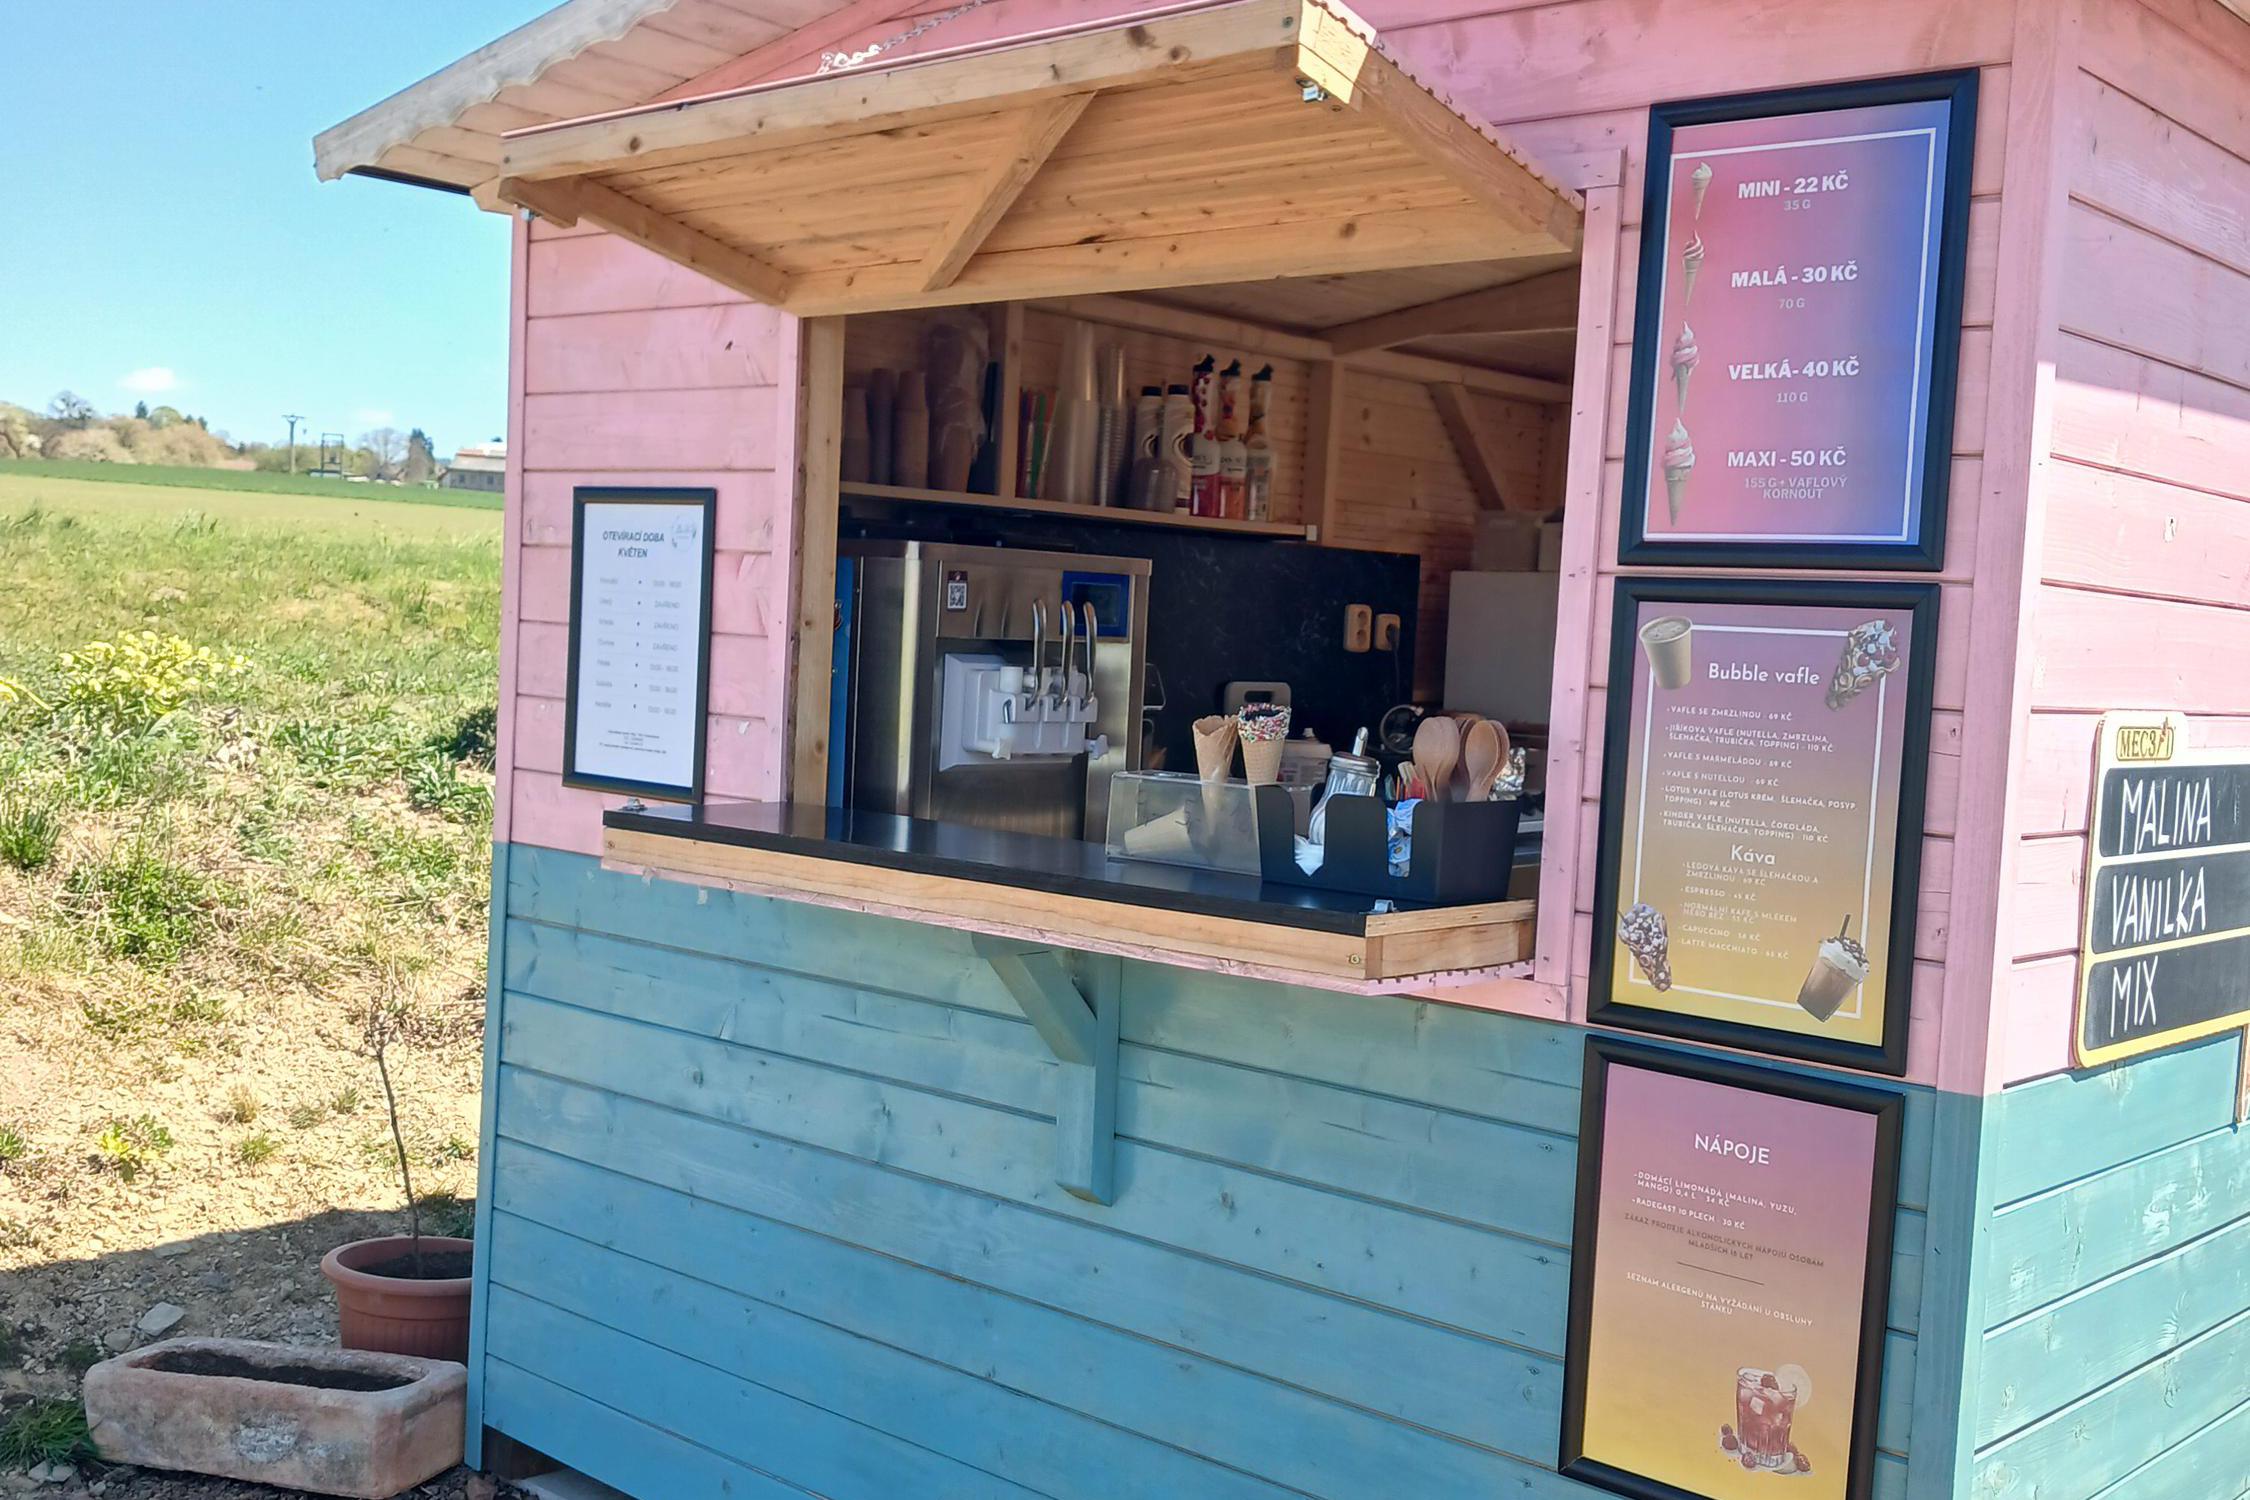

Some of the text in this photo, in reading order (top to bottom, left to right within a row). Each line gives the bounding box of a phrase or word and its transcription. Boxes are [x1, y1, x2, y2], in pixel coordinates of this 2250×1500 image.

[1738, 180, 1780, 198] MINI
[1793, 177, 1818, 194] 22
[1822, 170, 1848, 191] KČ
[1784, 199, 1811, 211] 35 G
[1732, 266, 1788, 288] MALÁ
[1802, 266, 1828, 284] 30
[1831, 260, 1858, 282] KČ
[1779, 298, 1805, 310] 70 G
[1802, 361, 1828, 378] 40
[1832, 356, 1859, 376] KČ
[1776, 392, 1808, 403] 110 G
[1728, 451, 1776, 468] MAXI
[1790, 450, 1815, 466] 50
[1820, 446, 1846, 466] KČ
[1744, 478, 1766, 488] 155
[1768, 477, 1777, 488] G
[1788, 474, 1848, 488] VAFLOVÝ
[1762, 488, 1824, 500] KORNOUT
[602, 530, 642, 541] OTEVÍRACÍ
[643, 532, 664, 542] DOBA
[618, 546, 648, 558] KVĚTEN
[1708, 662, 1820, 685] Bubble vafle
[1698, 708, 1708, 716] SE
[1712, 709, 1761, 720] ZMRZLINOU
[1780, 712, 1792, 721] KČ
[1709, 727, 1734, 736] VAFLE
[1780, 760, 1792, 769] KČ
[1702, 773, 1745, 784] NUTELLOU
[1693, 787, 1718, 797] VAFLE
[1697, 814, 1722, 824] VAFLE
[2118, 777, 2211, 855] MALINA
[1730, 844, 1776, 866] Káva
[2112, 866, 2206, 946] VANILKA
[2110, 955, 2158, 1038] MIX
[1694, 1133, 1770, 1165] NÁPOJE
[1637, 1180, 1672, 1194] MANGO)
[1718, 1196, 1730, 1208] KČ
[1688, 1210, 1716, 1223] PLECH
[1734, 1220, 1746, 1230] KČ
[1739, 1252, 1754, 1262] LET
[1626, 1271, 1660, 1288] SEZNAM
[1706, 1292, 1718, 1303] NA
[1765, 1308, 1771, 1316] U
[1773, 1310, 1813, 1327] OBSLUHY
